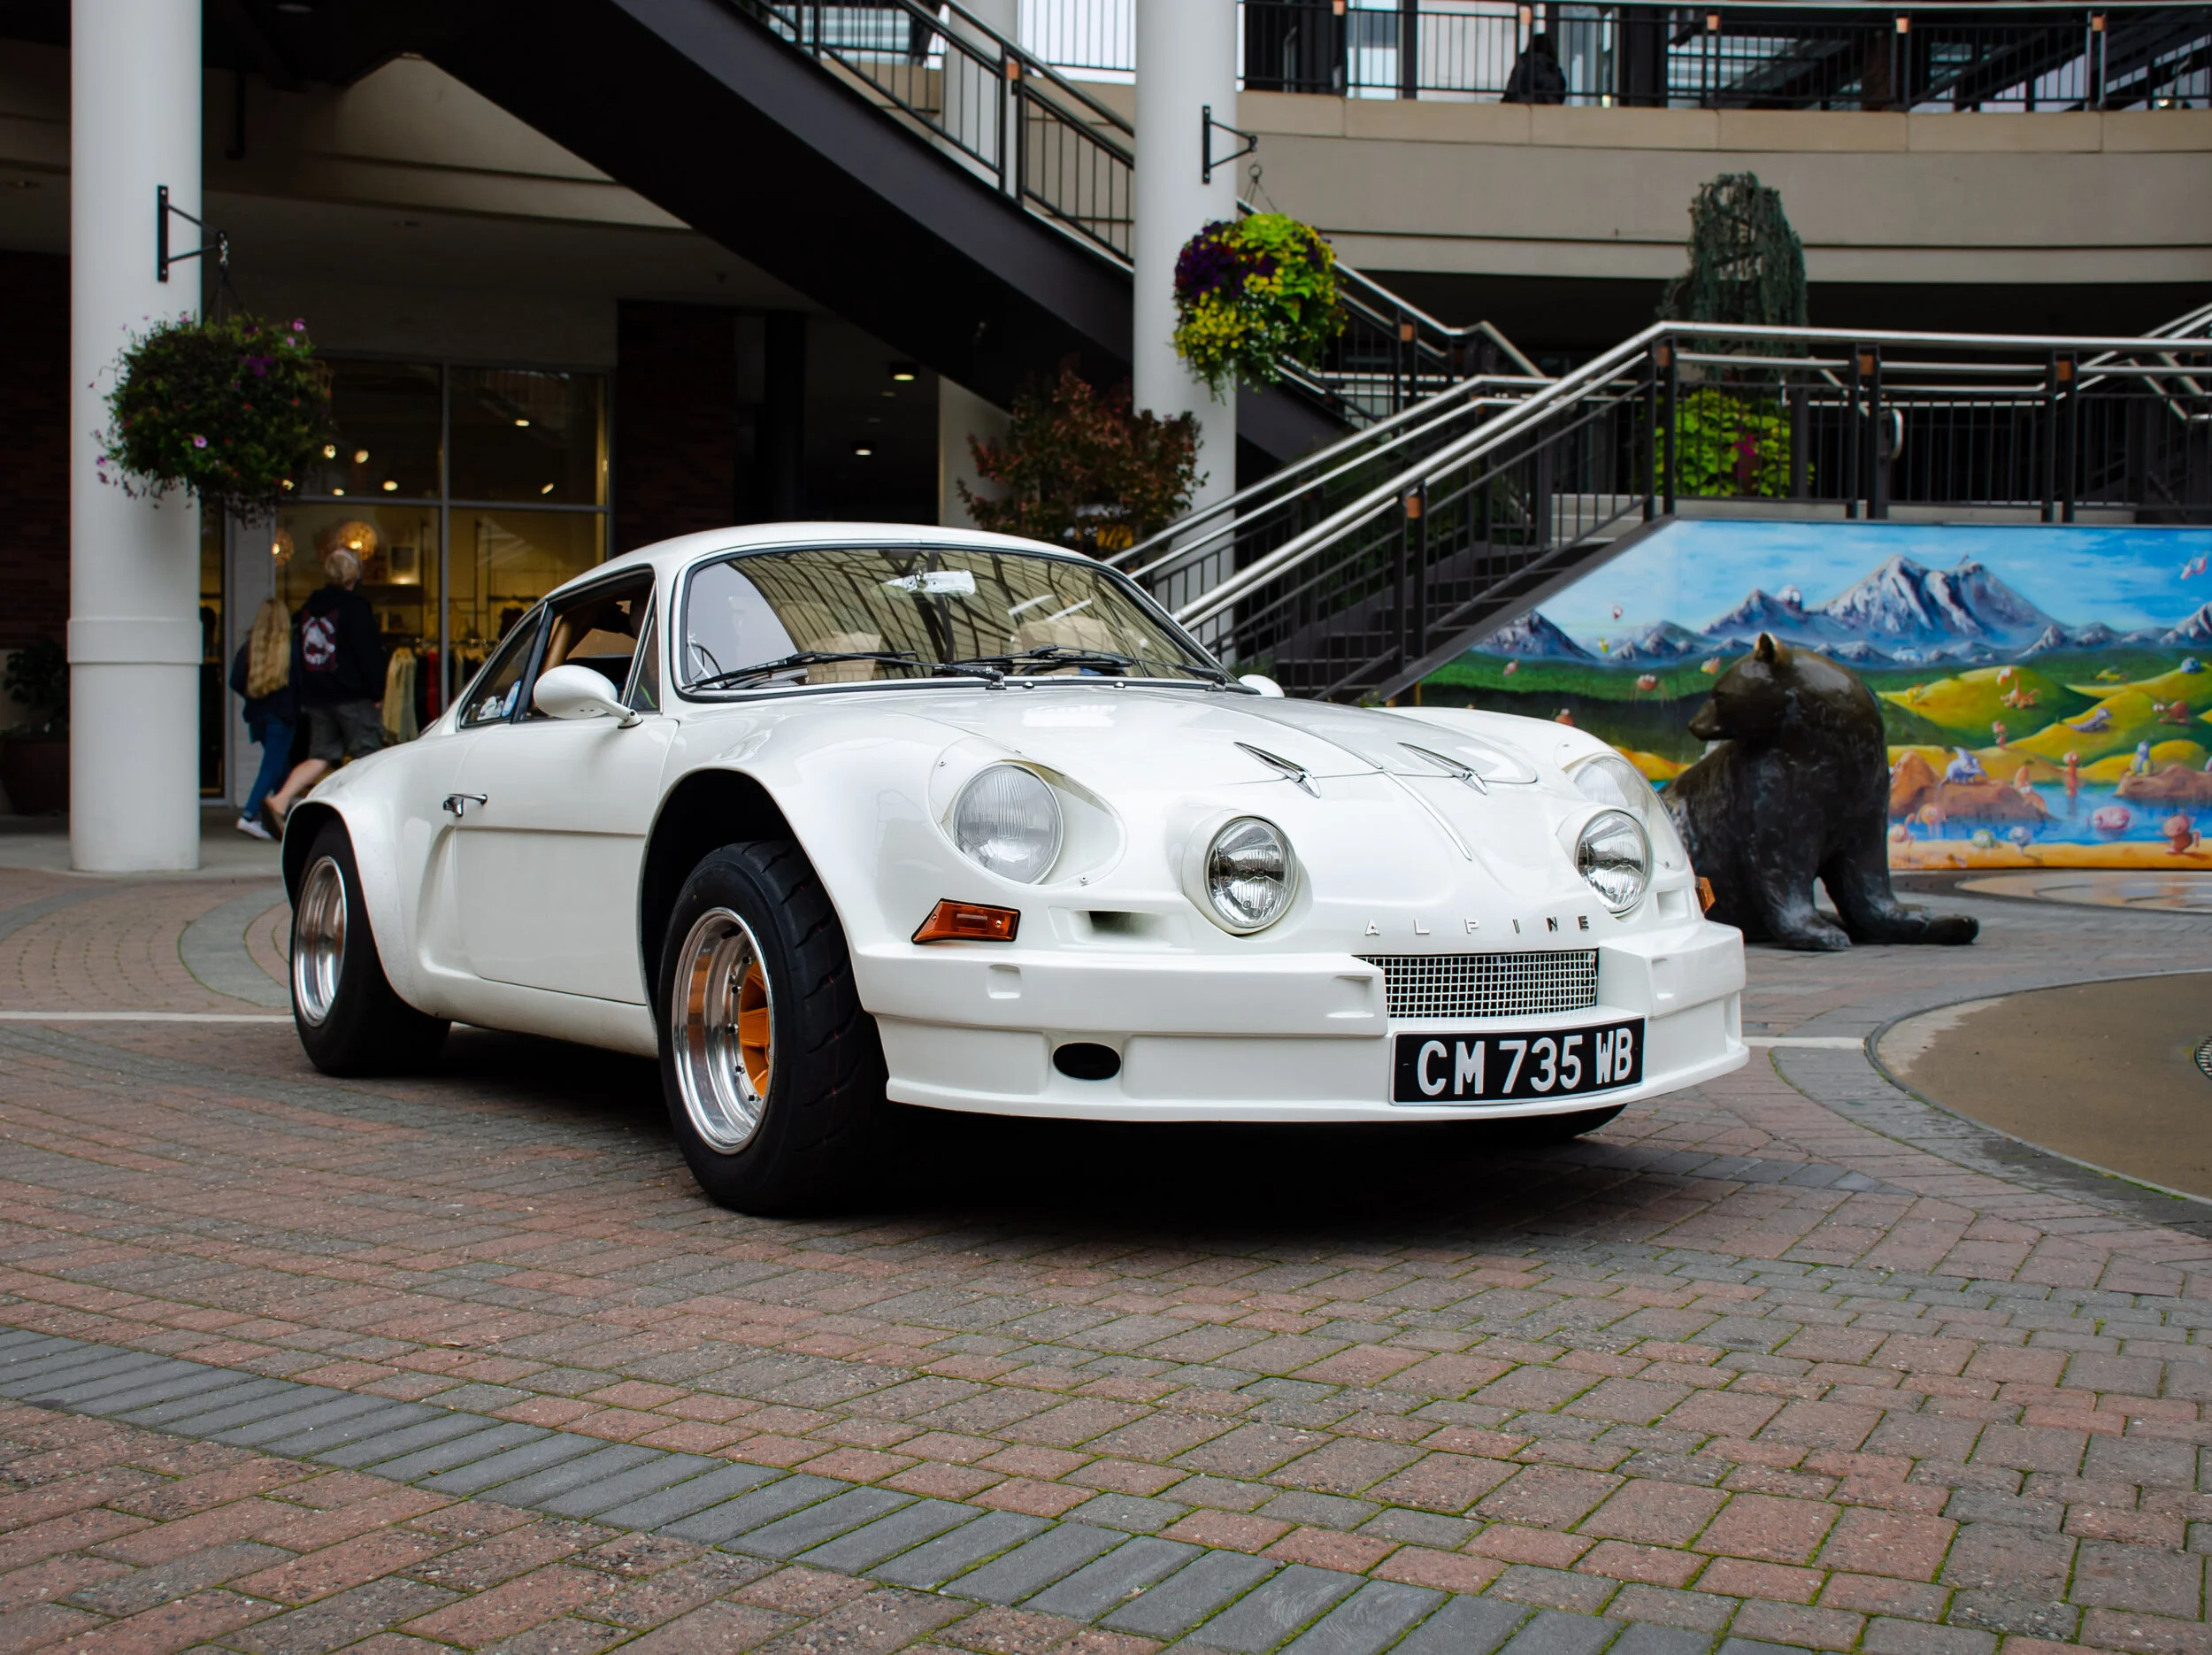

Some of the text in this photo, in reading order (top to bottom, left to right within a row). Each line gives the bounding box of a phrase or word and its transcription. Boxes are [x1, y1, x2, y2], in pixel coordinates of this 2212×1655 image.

[1364, 915, 1590, 935] ALPINE
[1417, 1028, 1633, 1096] CM 735 WB
